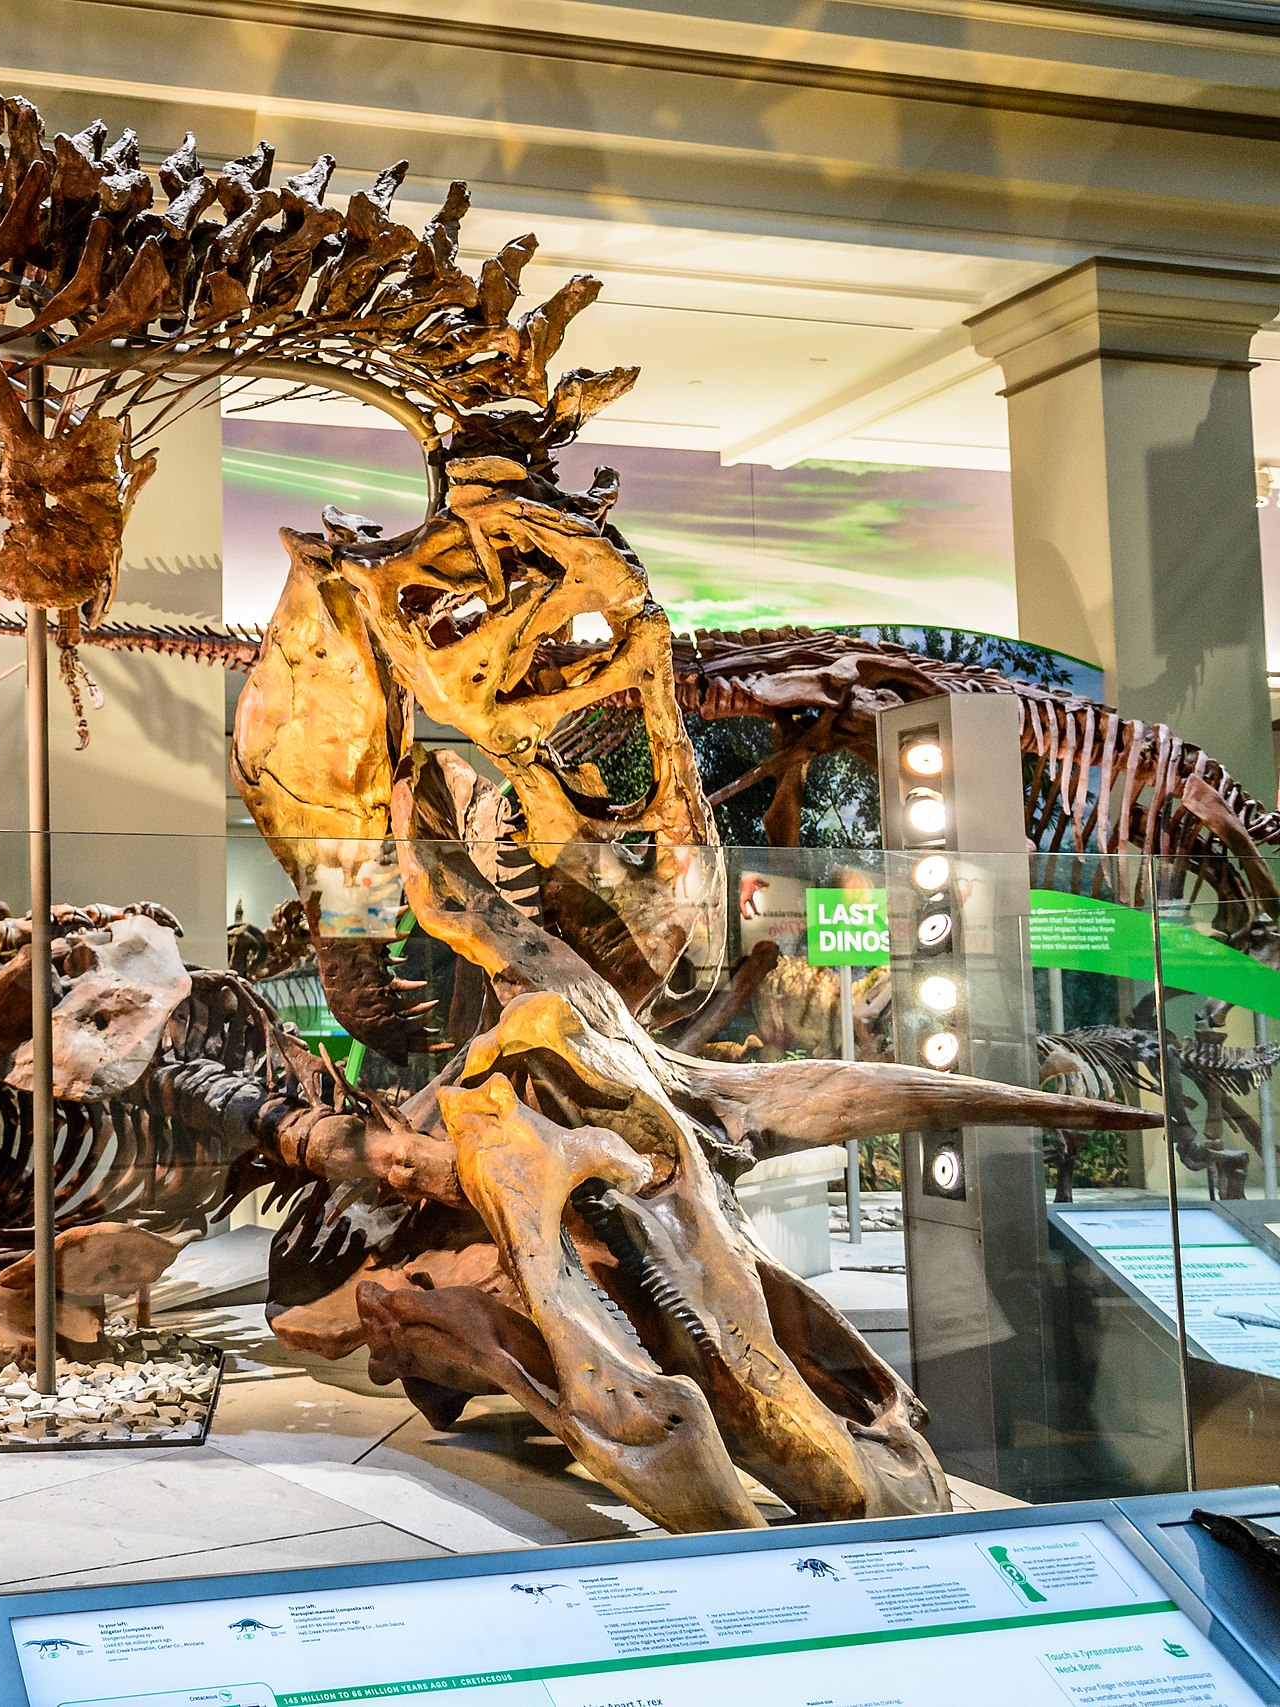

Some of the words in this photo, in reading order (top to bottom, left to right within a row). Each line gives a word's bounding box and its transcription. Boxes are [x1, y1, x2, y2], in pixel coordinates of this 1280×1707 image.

[819, 902, 879, 926] LAST
[101, 1627, 121, 1635] Alligator
[123, 1626, 150, 1634] (composite
[1045, 1651, 1072, 1661] Touch
[1072, 1650, 1080, 1658] a
[1077, 1645, 1143, 1659] Tyrannosaurus
[1055, 1664, 1079, 1674] Neck
[1077, 1664, 1101, 1672] Bone
[284, 1697, 298, 1705] 145
[301, 1693, 336, 1703] MILLION
[338, 1691, 350, 1702] TO
[352, 1690, 362, 1698] 66
[364, 1686, 399, 1696] MILLION
[401, 1683, 428, 1692] YEARS
[431, 1681, 447, 1689] AGO
[461, 1674, 512, 1686] CRETACEOUS
[1082, 1683, 1098, 1693] your
[1096, 1683, 1116, 1691] finger
[1136, 1677, 1156, 1687] space
[1166, 1672, 1212, 1684] Tyrannosaurus
[1136, 1688, 1157, 1697] flowed
[1156, 1685, 1183, 1695] through
[647, 1699, 662, 1707] rex
